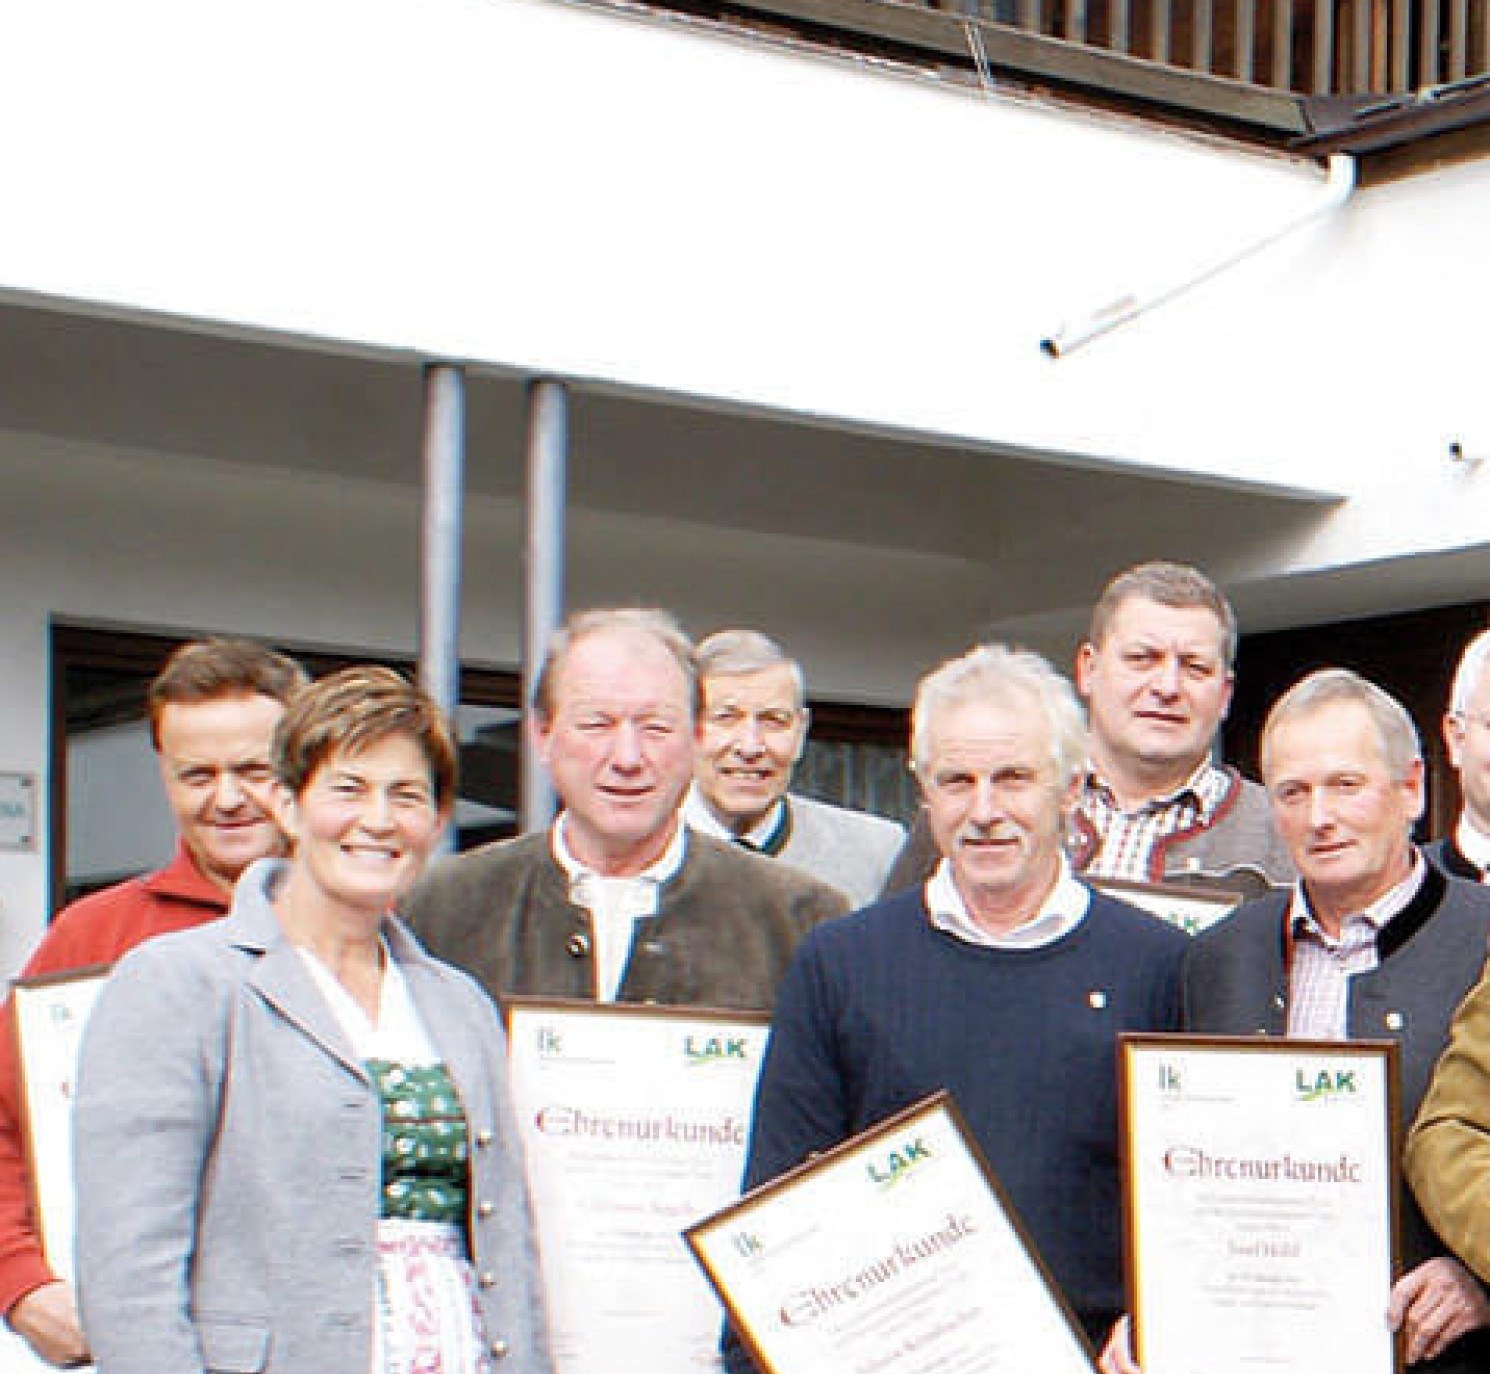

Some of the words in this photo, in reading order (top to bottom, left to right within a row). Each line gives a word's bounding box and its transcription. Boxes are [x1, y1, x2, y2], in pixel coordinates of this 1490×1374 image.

[685, 1036, 747, 1059] LAK
[1295, 1067, 1357, 1094] LAK
[867, 1137, 933, 1183] LAK
